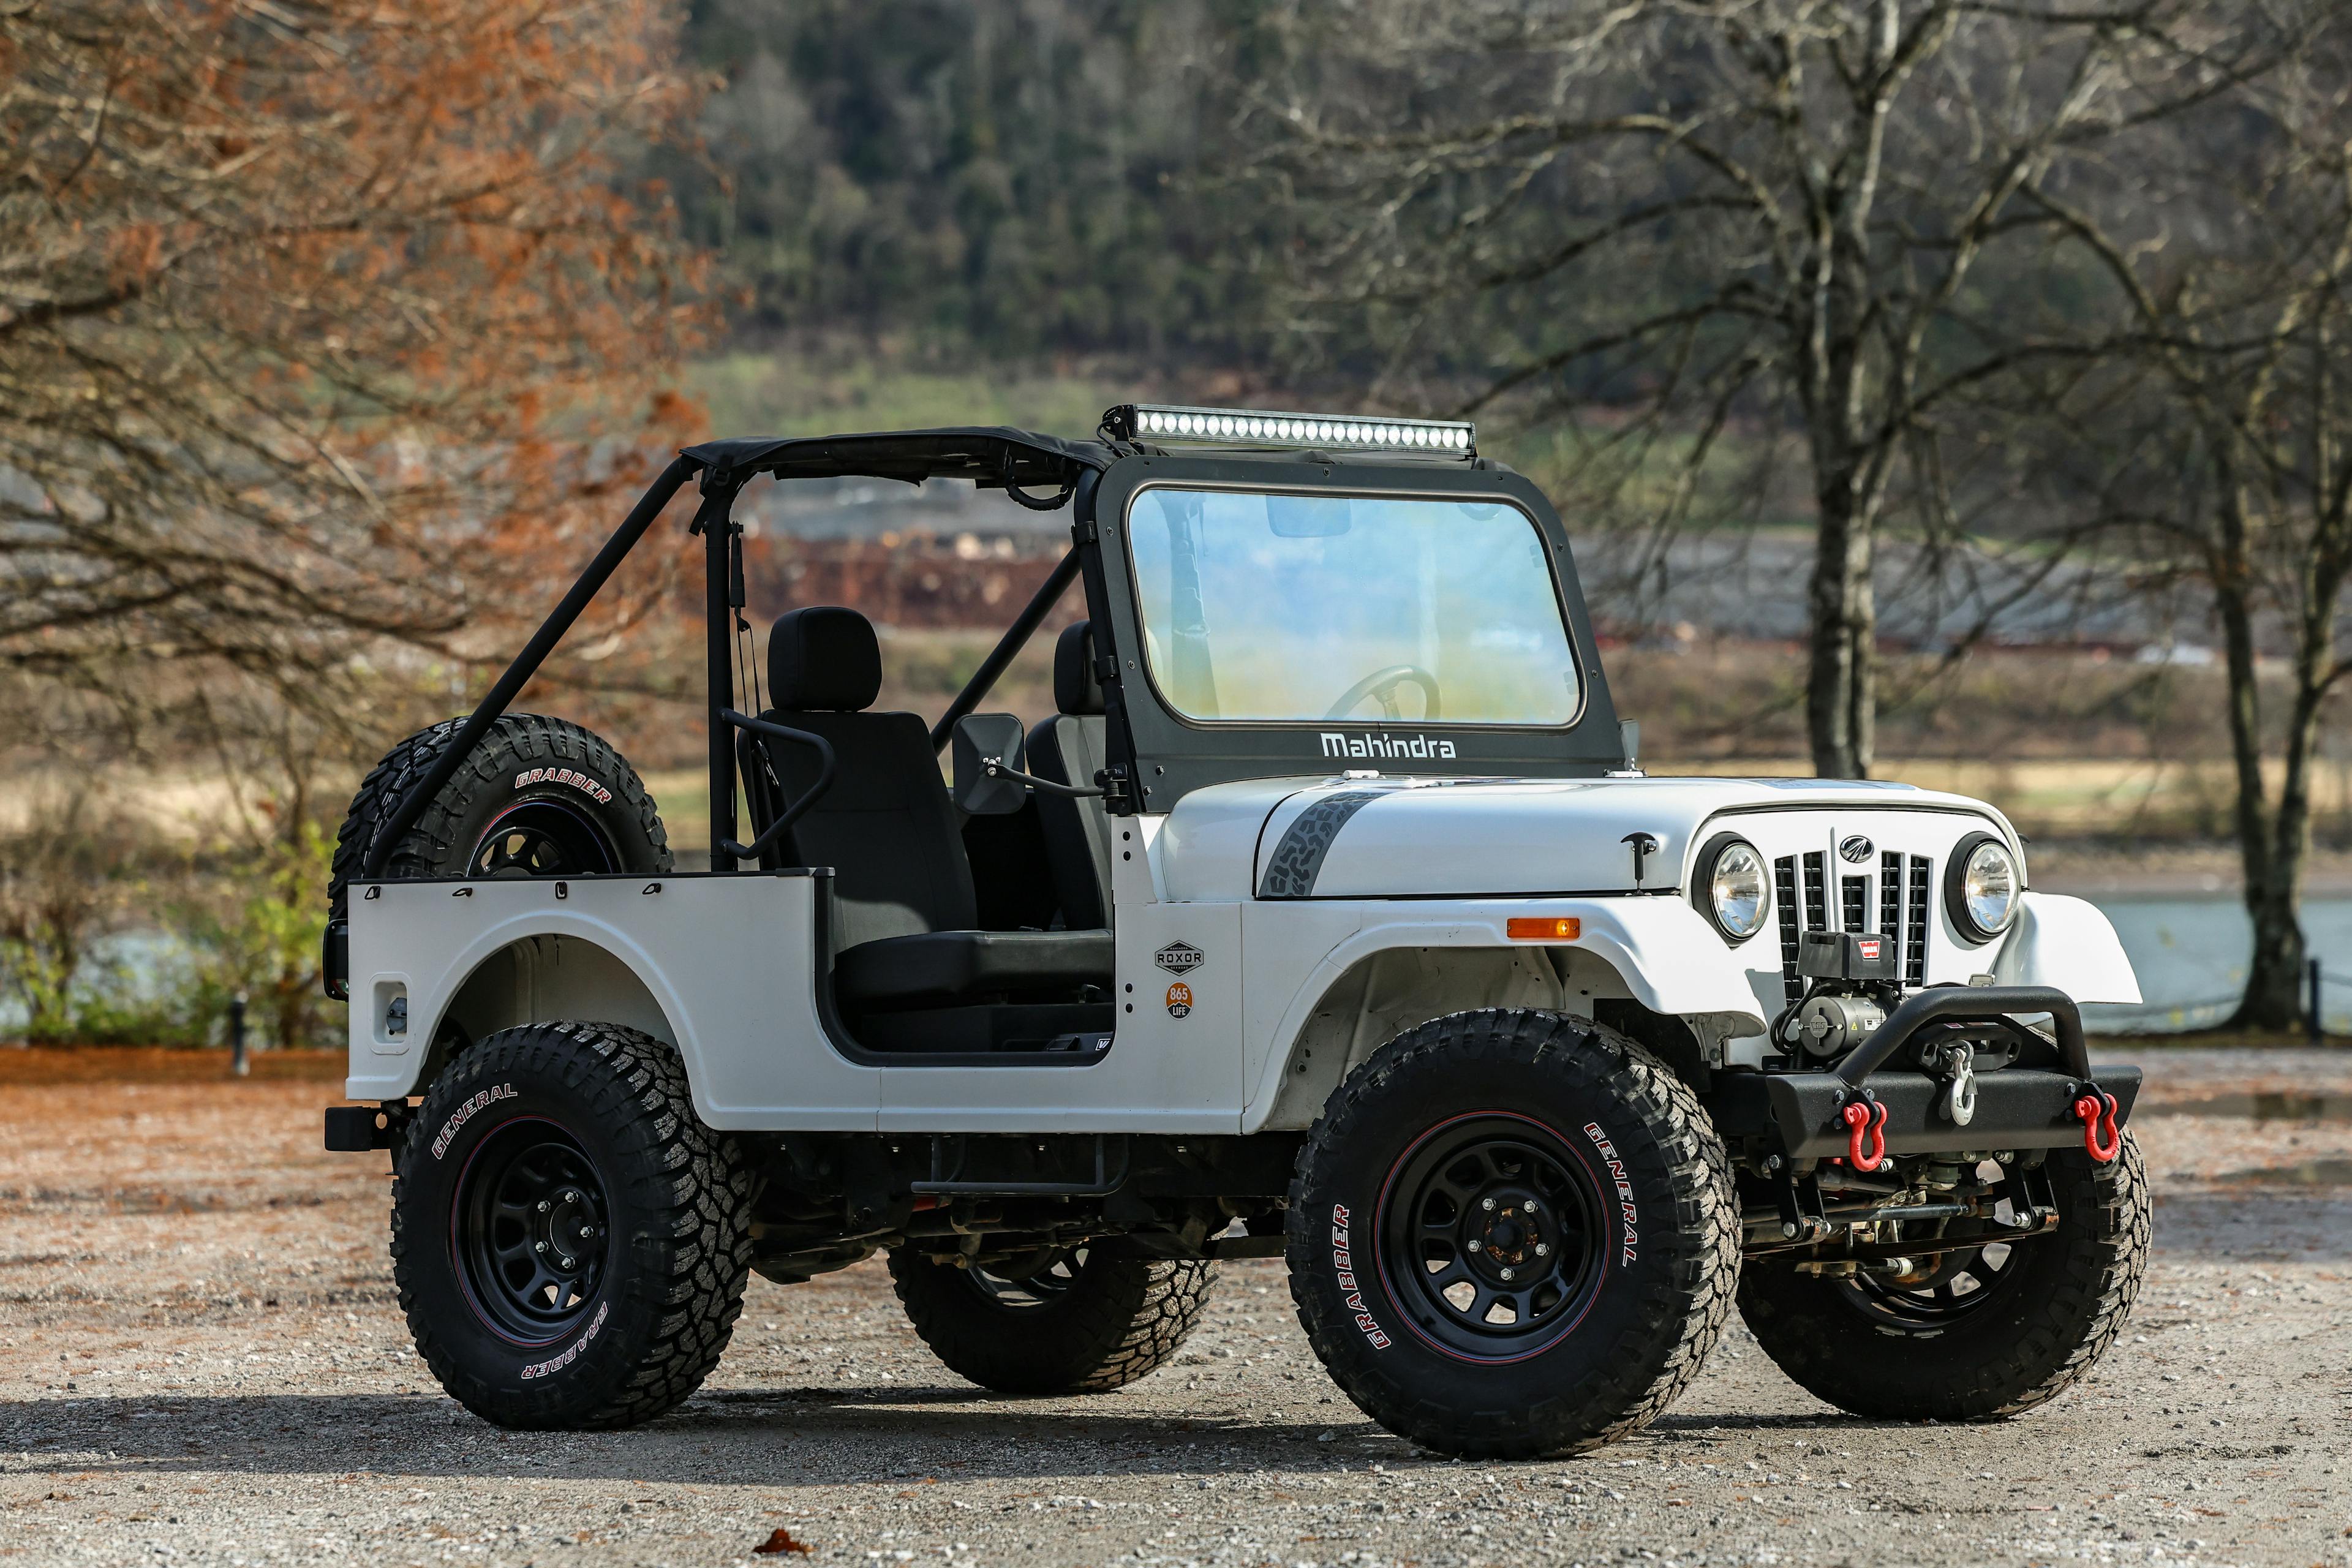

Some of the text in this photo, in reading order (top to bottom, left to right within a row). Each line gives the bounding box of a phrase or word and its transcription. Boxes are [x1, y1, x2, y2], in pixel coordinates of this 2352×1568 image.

[1320, 733, 1457, 759] Mahindra
[514, 767, 612, 804] GRABBER
[1157, 952, 1202, 963] ROXOR
[1170, 987, 1188, 1000] 865
[1172, 1006, 1186, 1016] LIFE
[431, 1083, 518, 1160] GENERAL
[1583, 1121, 1638, 1267] GENERAL
[1332, 1204, 1392, 1350] GRABBER
[521, 1301, 608, 1379] GRABBER
